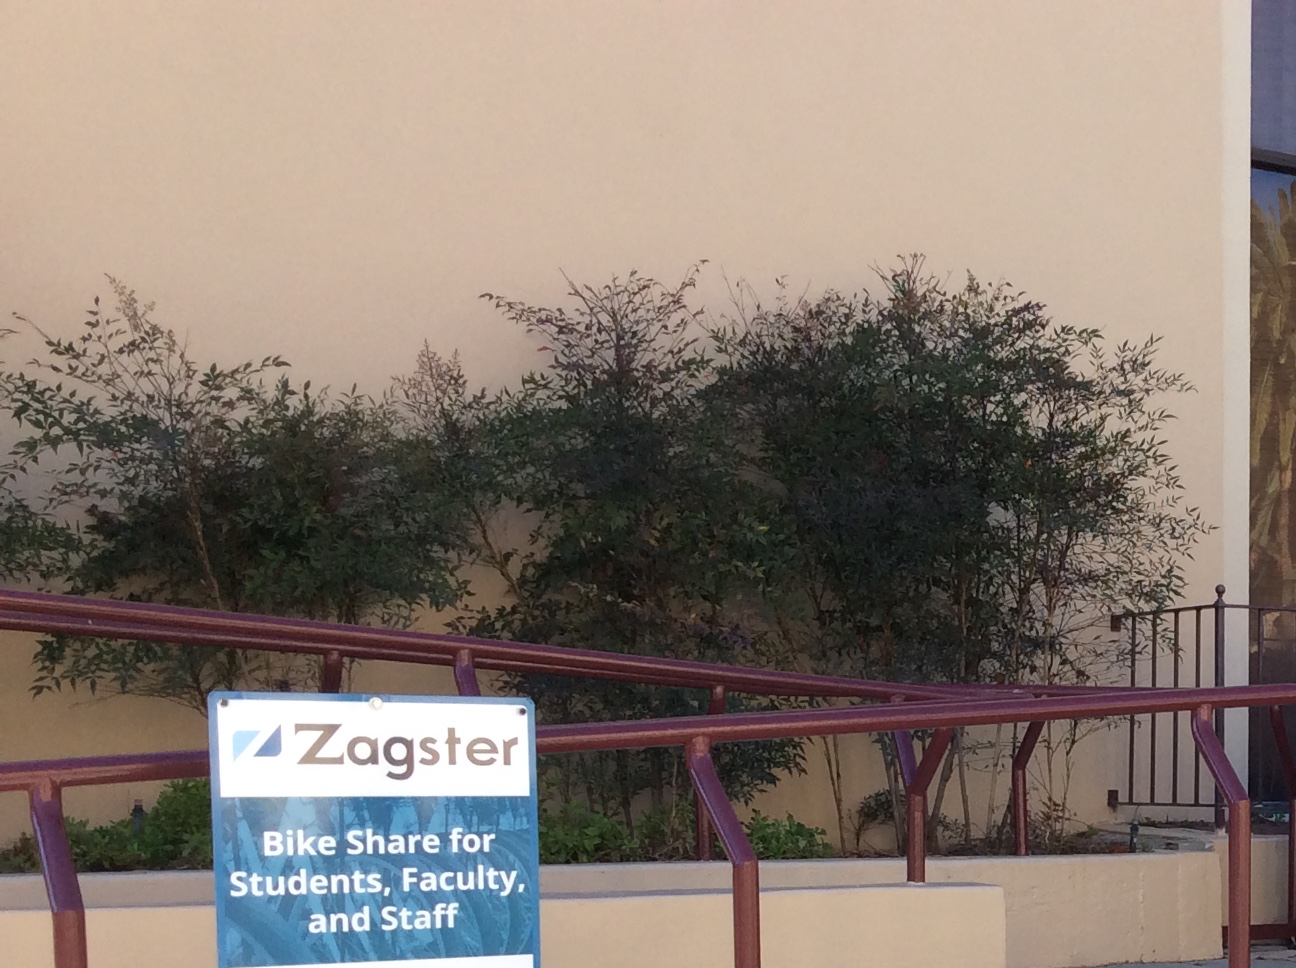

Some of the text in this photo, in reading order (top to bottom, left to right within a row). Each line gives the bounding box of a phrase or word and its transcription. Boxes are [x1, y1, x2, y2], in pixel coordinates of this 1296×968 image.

[294, 723, 519, 781] Zagster
[263, 827, 496, 856] Bike Share for
[229, 865, 526, 897] Students, Faculty,
[308, 902, 459, 934] and Staff
